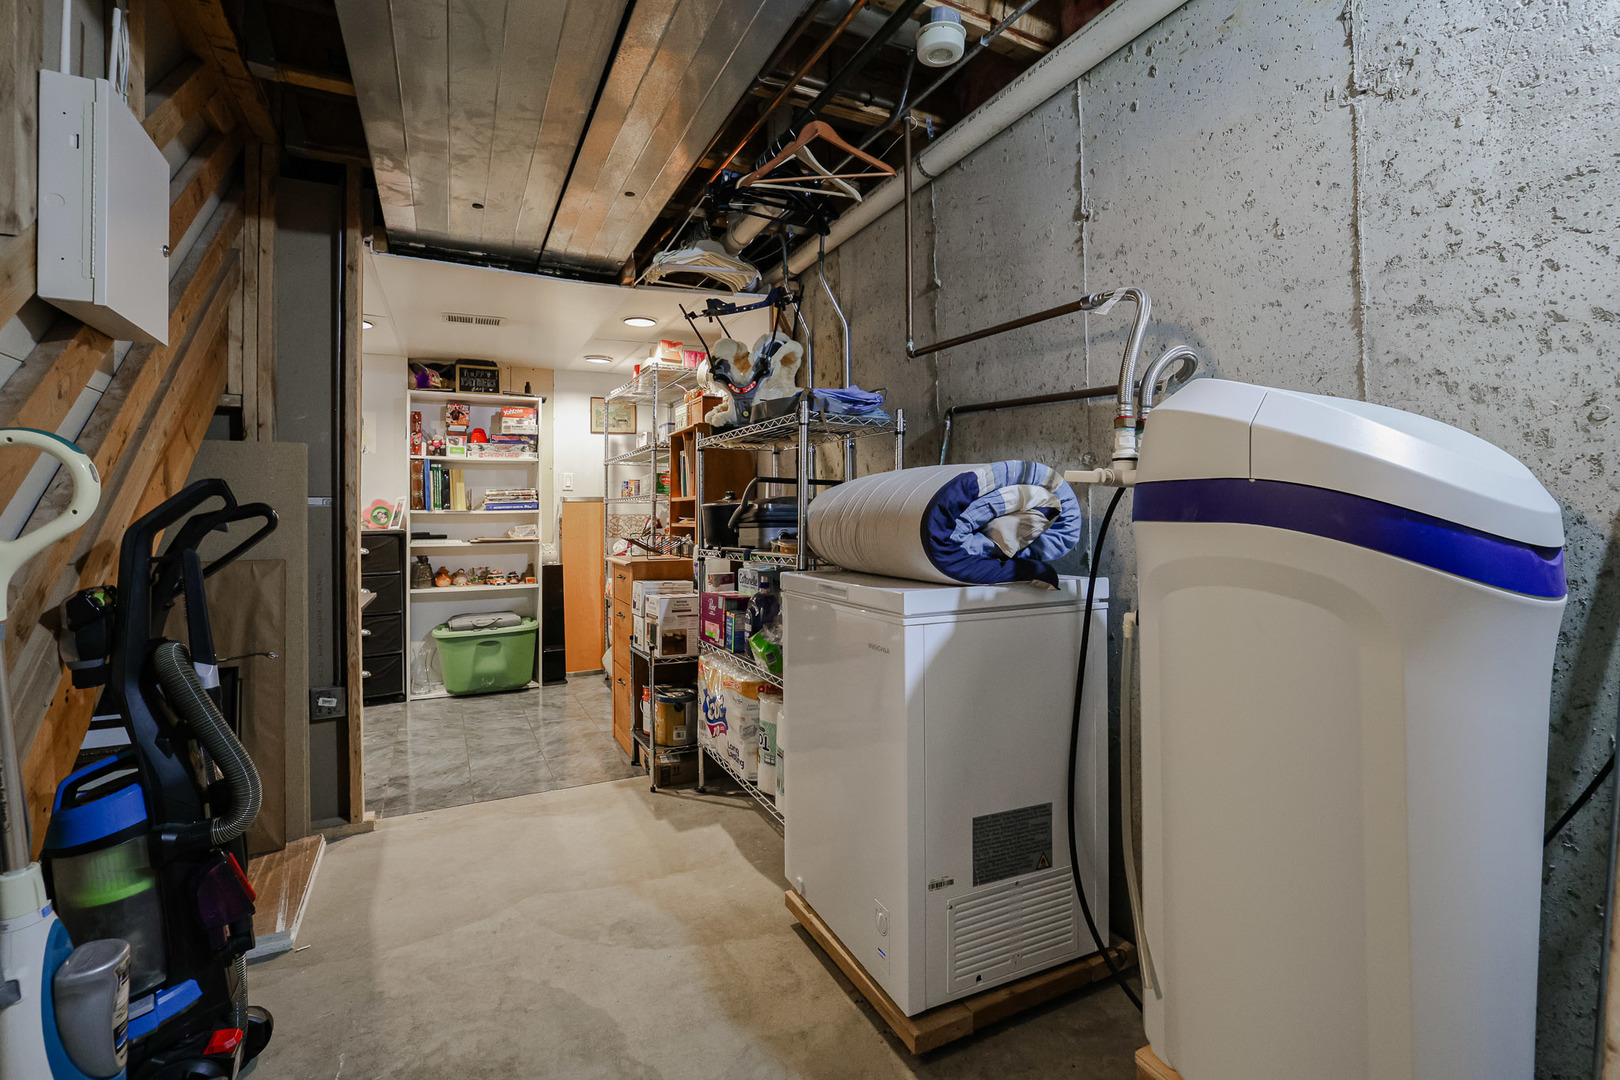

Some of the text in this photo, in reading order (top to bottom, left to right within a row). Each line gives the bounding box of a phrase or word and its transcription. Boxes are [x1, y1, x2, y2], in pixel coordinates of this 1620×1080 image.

[985, 87, 1013, 110] CHARLOTTE
[1014, 76, 1026, 89] PIPE
[503, 408, 524, 417] Yahtzee
[739, 572, 759, 587] Cottonelle
[868, 643, 891, 655] INSIGNIA
